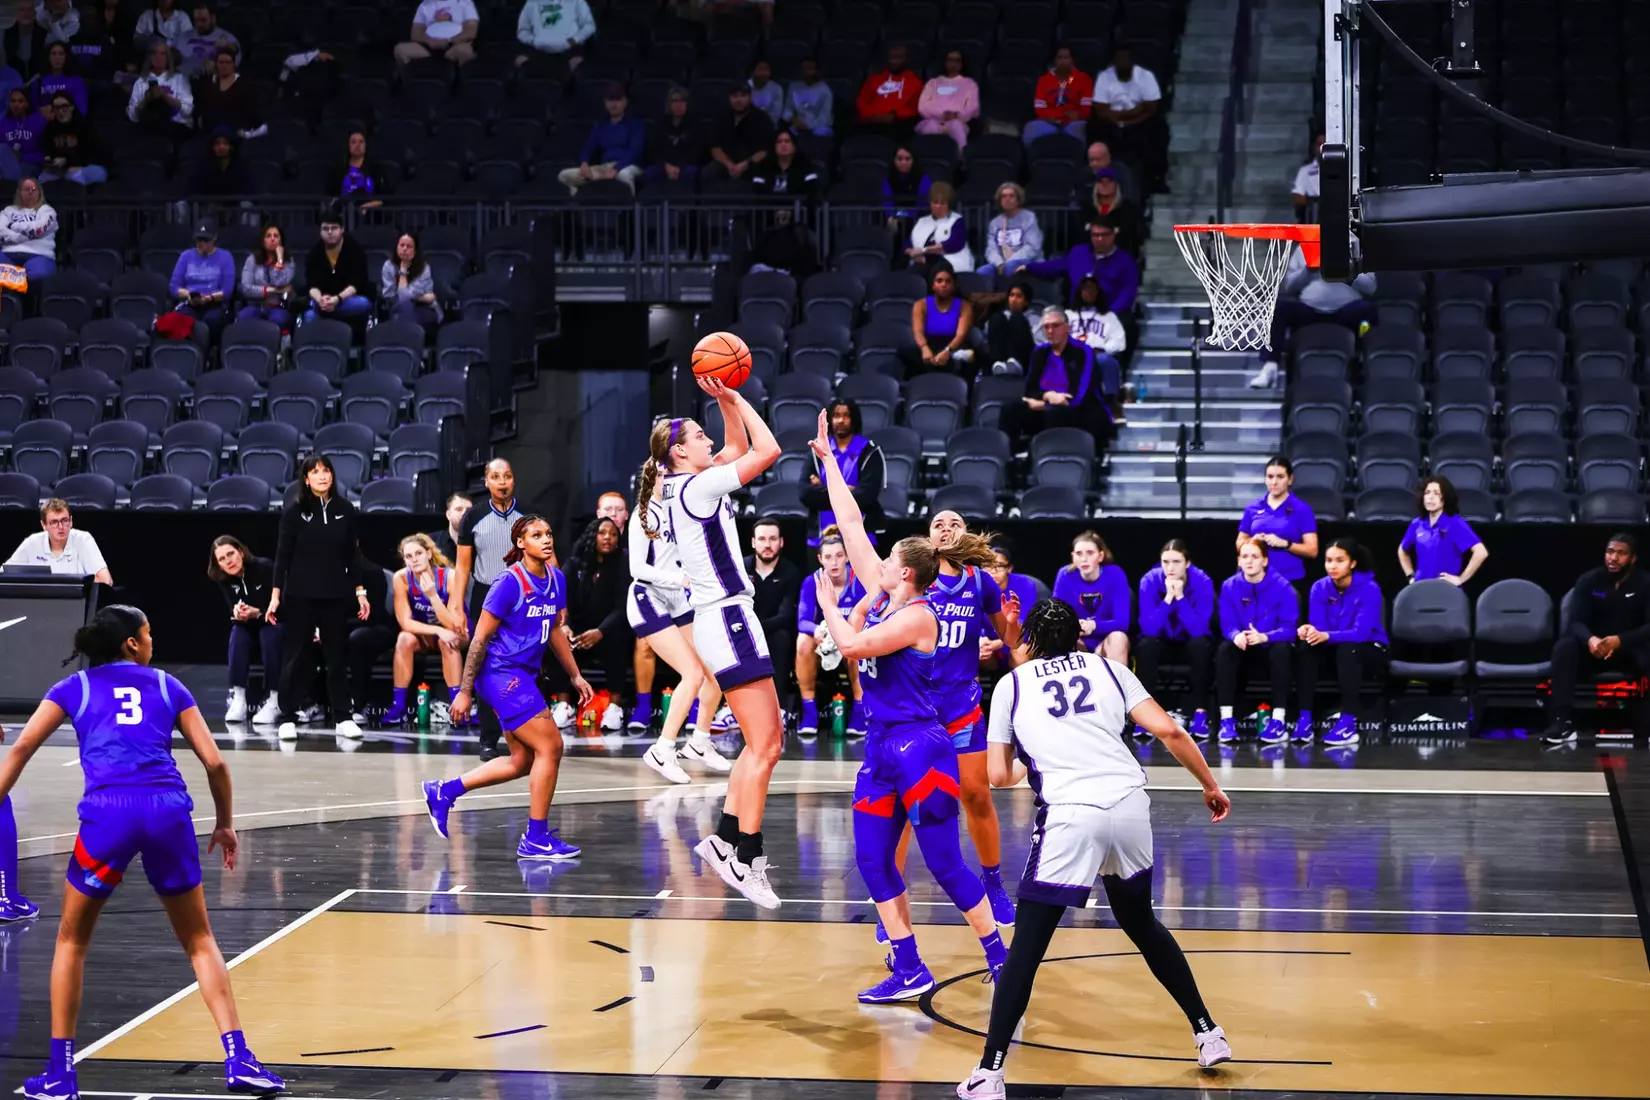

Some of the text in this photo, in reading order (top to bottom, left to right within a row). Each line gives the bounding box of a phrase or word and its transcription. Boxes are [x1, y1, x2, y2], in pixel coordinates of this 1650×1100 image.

[540, 618, 550, 645] 0
[937, 620, 967, 649] 30
[1034, 654, 1087, 678] LESTER
[113, 686, 143, 726] 3
[1042, 675, 1097, 719] 32
[1390, 720, 1468, 732] SUMMERLIN
